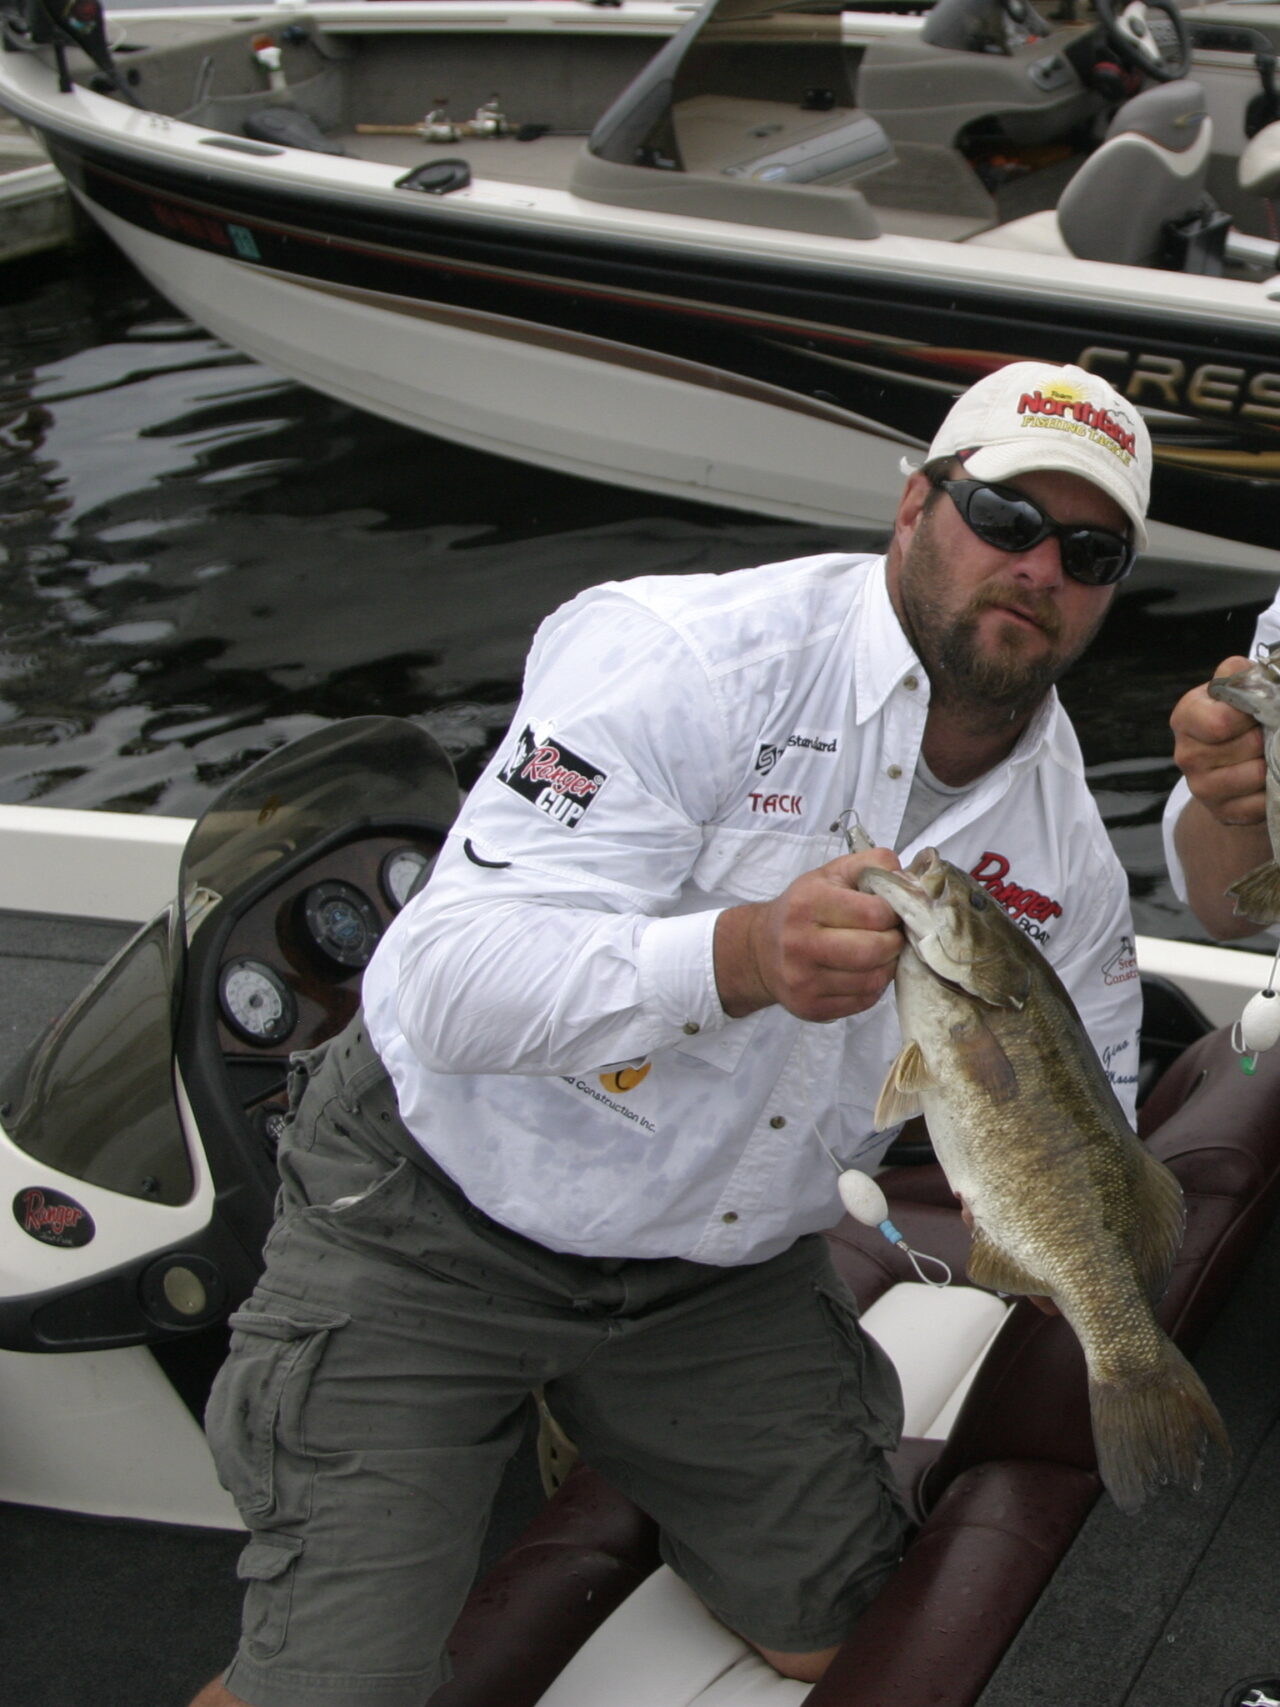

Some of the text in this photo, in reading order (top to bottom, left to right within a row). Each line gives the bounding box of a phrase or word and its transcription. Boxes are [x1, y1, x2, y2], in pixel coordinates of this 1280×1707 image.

[1017, 390, 1136, 457] Northland
[1021, 414, 1133, 467] FISHING TACKLE
[787, 735, 837, 752] Standard
[520, 746, 598, 798] Ranger
[536, 786, 584, 826] CUP
[748, 793, 802, 815] TACK
[576, 1080, 656, 1133] Construction Inc.
[22, 1189, 84, 1235] Ranger
